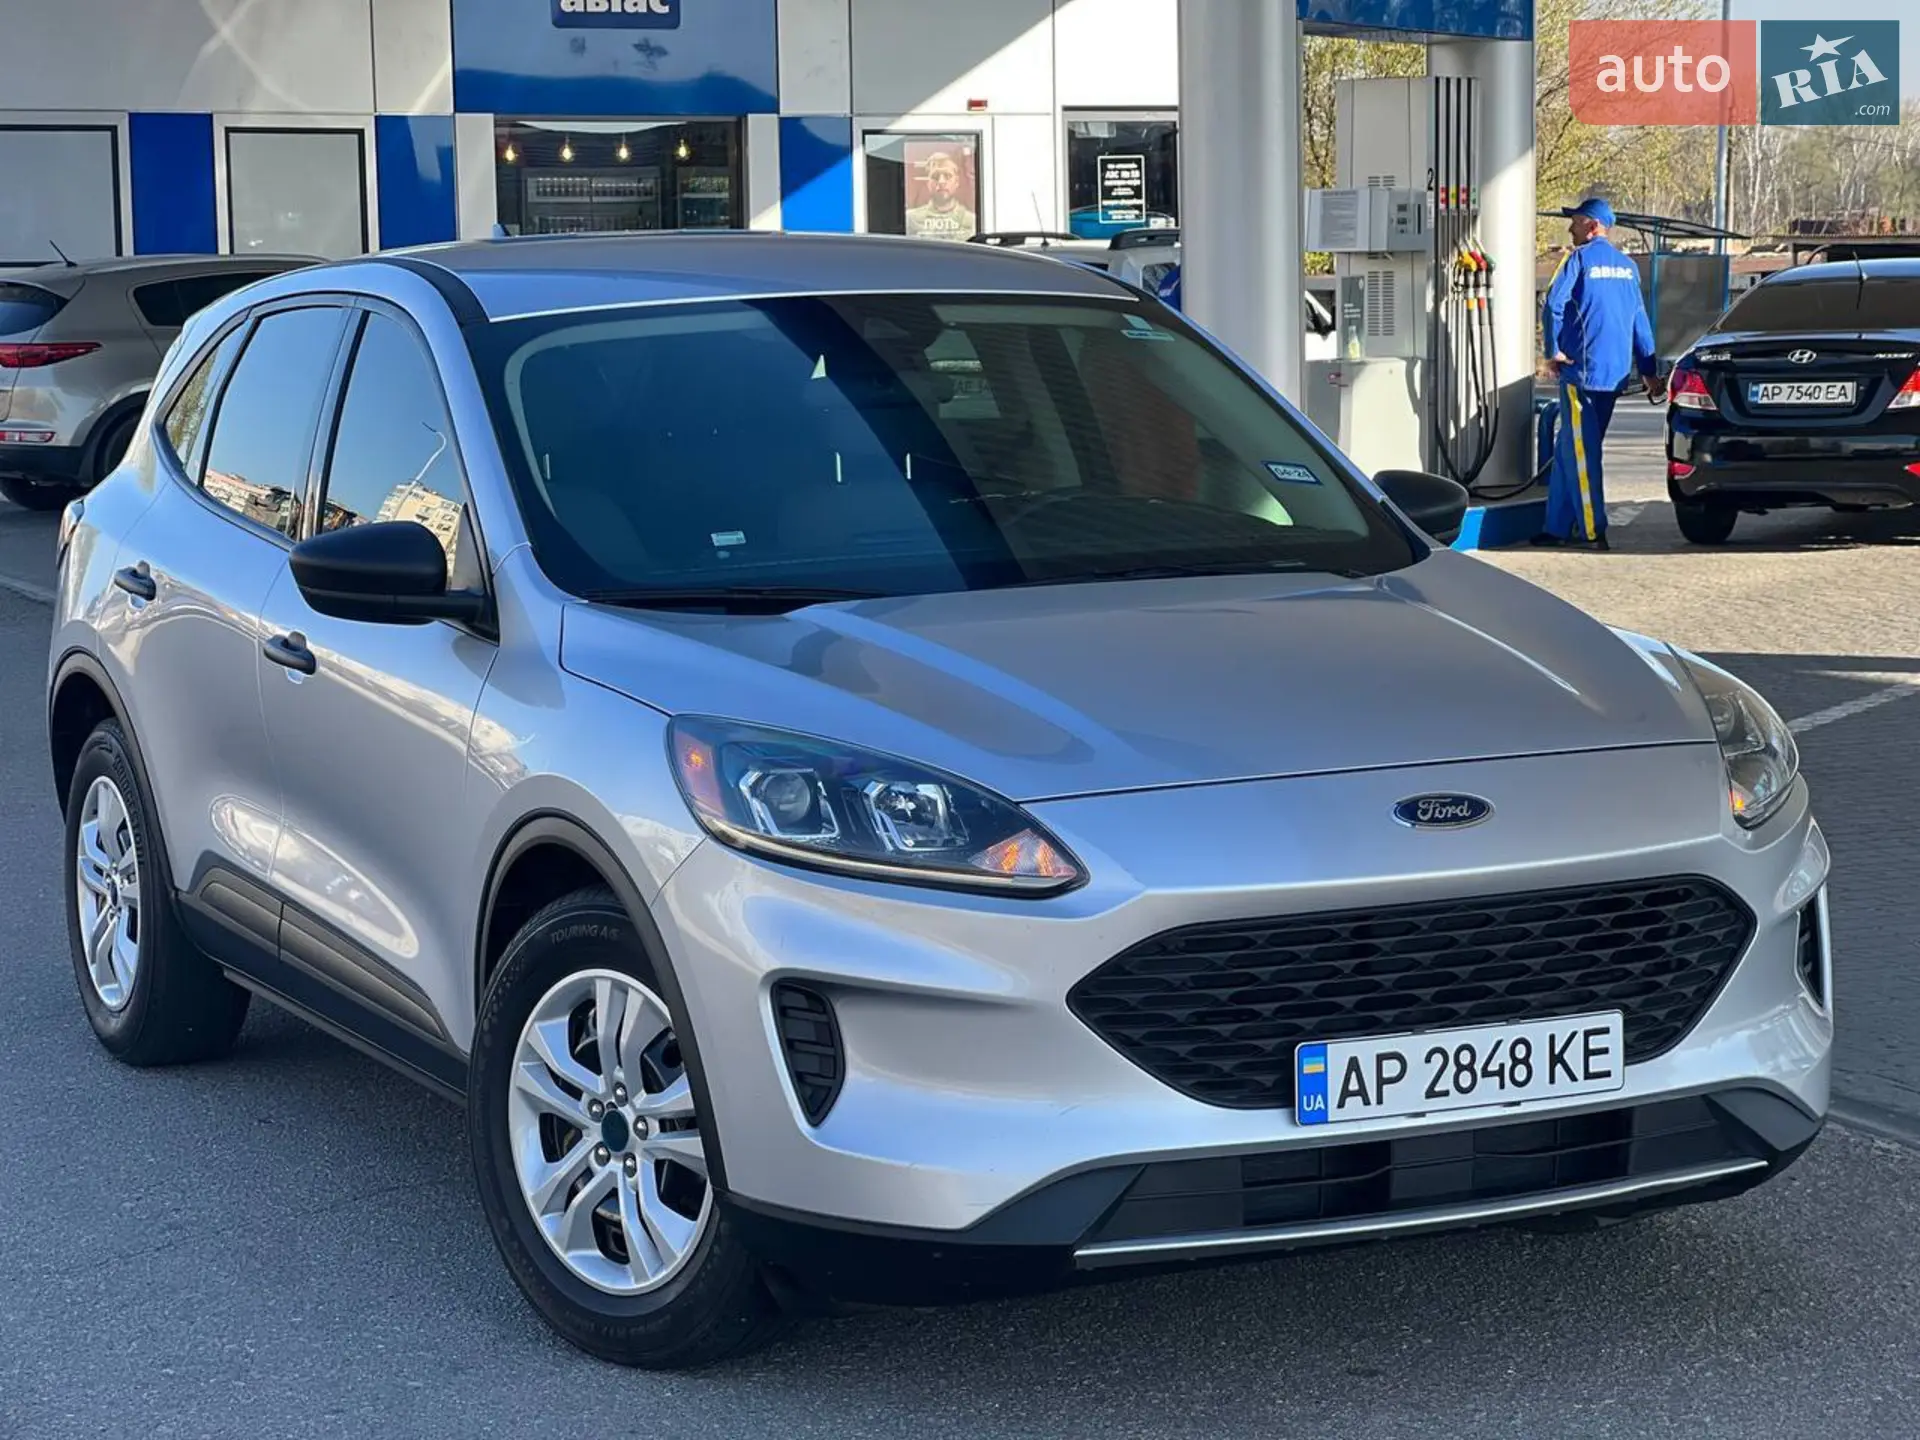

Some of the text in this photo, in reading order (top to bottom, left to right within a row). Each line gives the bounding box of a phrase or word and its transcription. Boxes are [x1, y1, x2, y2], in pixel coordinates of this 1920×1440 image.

[1426, 167, 1435, 192] 2
[1760, 384, 1849, 401] AP 7540 EA
[1417, 798, 1472, 821] Ford
[1336, 1025, 1613, 1110] AP 2848 KE
[1303, 1092, 1326, 1112] UA
